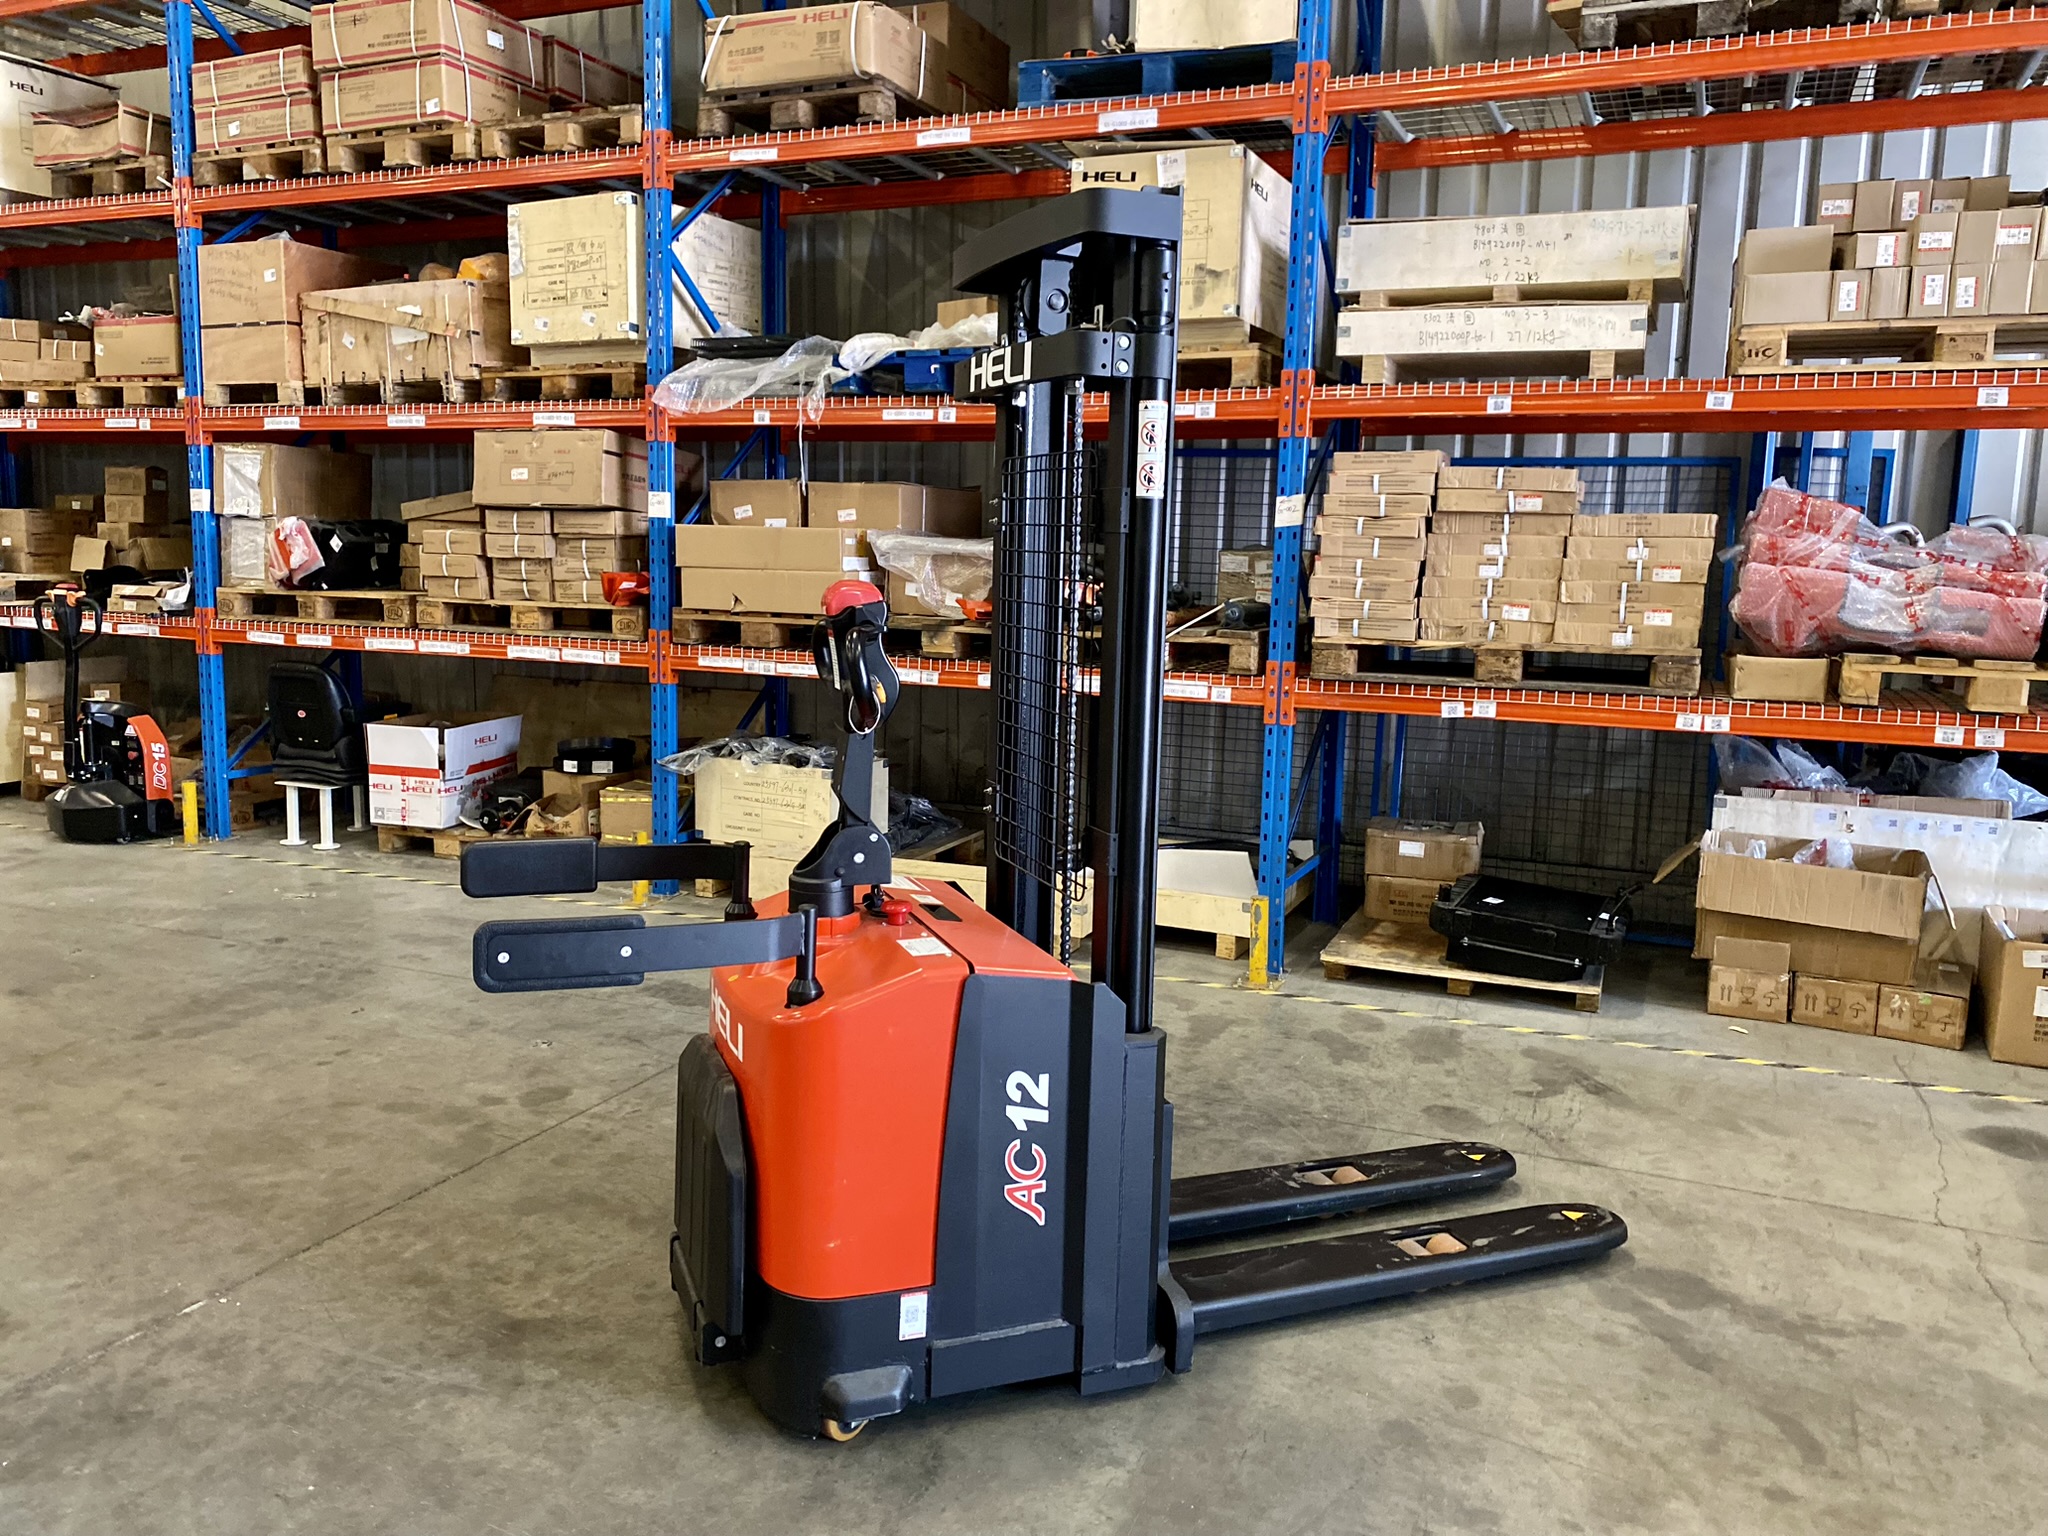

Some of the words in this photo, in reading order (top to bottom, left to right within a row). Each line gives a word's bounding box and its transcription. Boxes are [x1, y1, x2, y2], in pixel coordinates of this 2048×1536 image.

[803, 8, 848, 24] HELI
[10, 80, 44, 96] HELI
[1082, 171, 1137, 182] HELI
[1250, 178, 1269, 202] HELI
[969, 342, 1032, 392] HELI
[474, 733, 498, 746] HELI
[150, 742, 166, 761] 15
[153, 761, 167, 790] DC
[406, 785, 433, 794] HELI
[438, 784, 463, 795] HELI
[711, 976, 744, 1063] HELI
[1005, 1070, 1050, 1131] 12
[1004, 1138, 1048, 1227] AC
